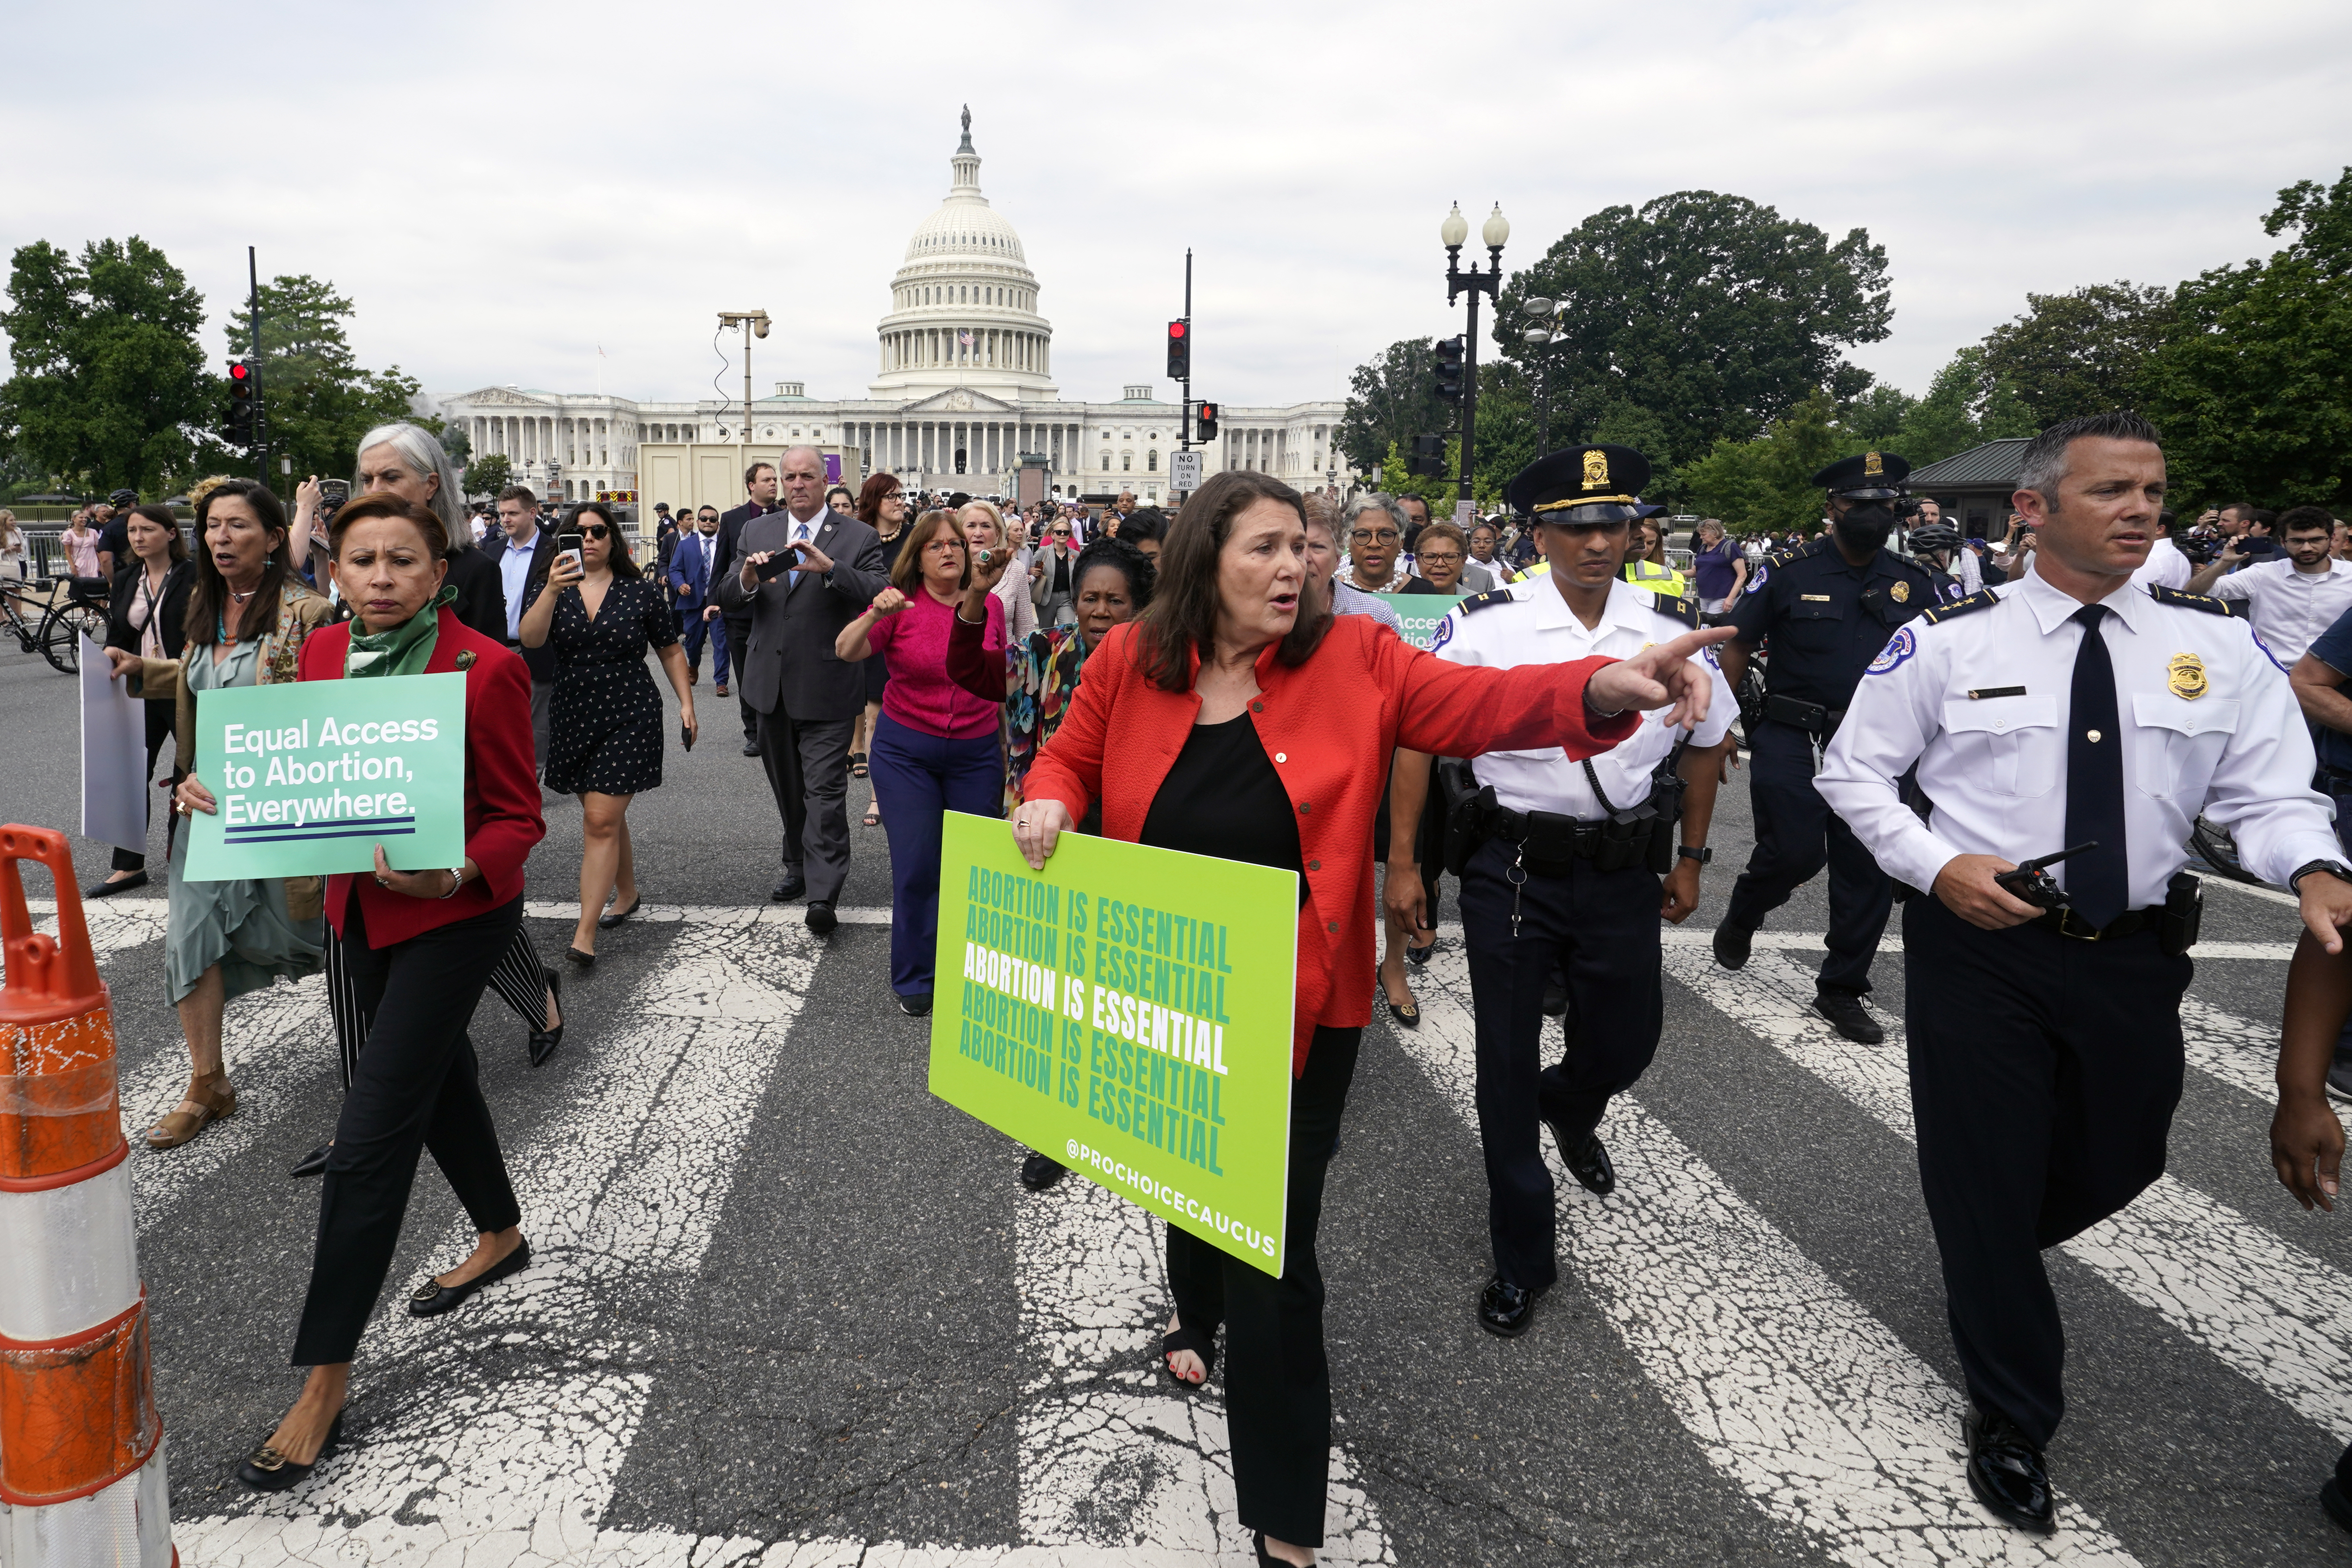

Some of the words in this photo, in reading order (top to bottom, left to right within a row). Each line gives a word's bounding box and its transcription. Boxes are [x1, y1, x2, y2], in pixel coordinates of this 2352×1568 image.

[224, 761, 256, 789] to
[265, 751, 413, 787] Abortion,
[225, 719, 308, 757] Equal
[318, 717, 438, 747] Access
[225, 789, 416, 827] Everywhere.
[966, 904, 1058, 968] ABORTION
[1066, 933, 1086, 977] IS
[1095, 941, 1230, 1025] ESSENTIAL
[967, 865, 1060, 926] ABORTION
[1067, 889, 1088, 933] IS
[1097, 897, 1232, 974] ESSENTIAL
[962, 981, 1054, 1054] ABORTION
[1061, 1022, 1083, 1065] IS
[1091, 1030, 1226, 1126] ESSENTIAL
[963, 942, 1056, 1011] ABORTION
[1063, 975, 1085, 1022] IS
[1092, 985, 1228, 1076] ESSENTIAL
[959, 1020, 1052, 1096] ABORTION
[1059, 1061, 1080, 1109] IS
[1088, 1076, 1223, 1177] ESSENTIAL
[1066, 1139, 1276, 1257] @PROCHOICECAUCUS
